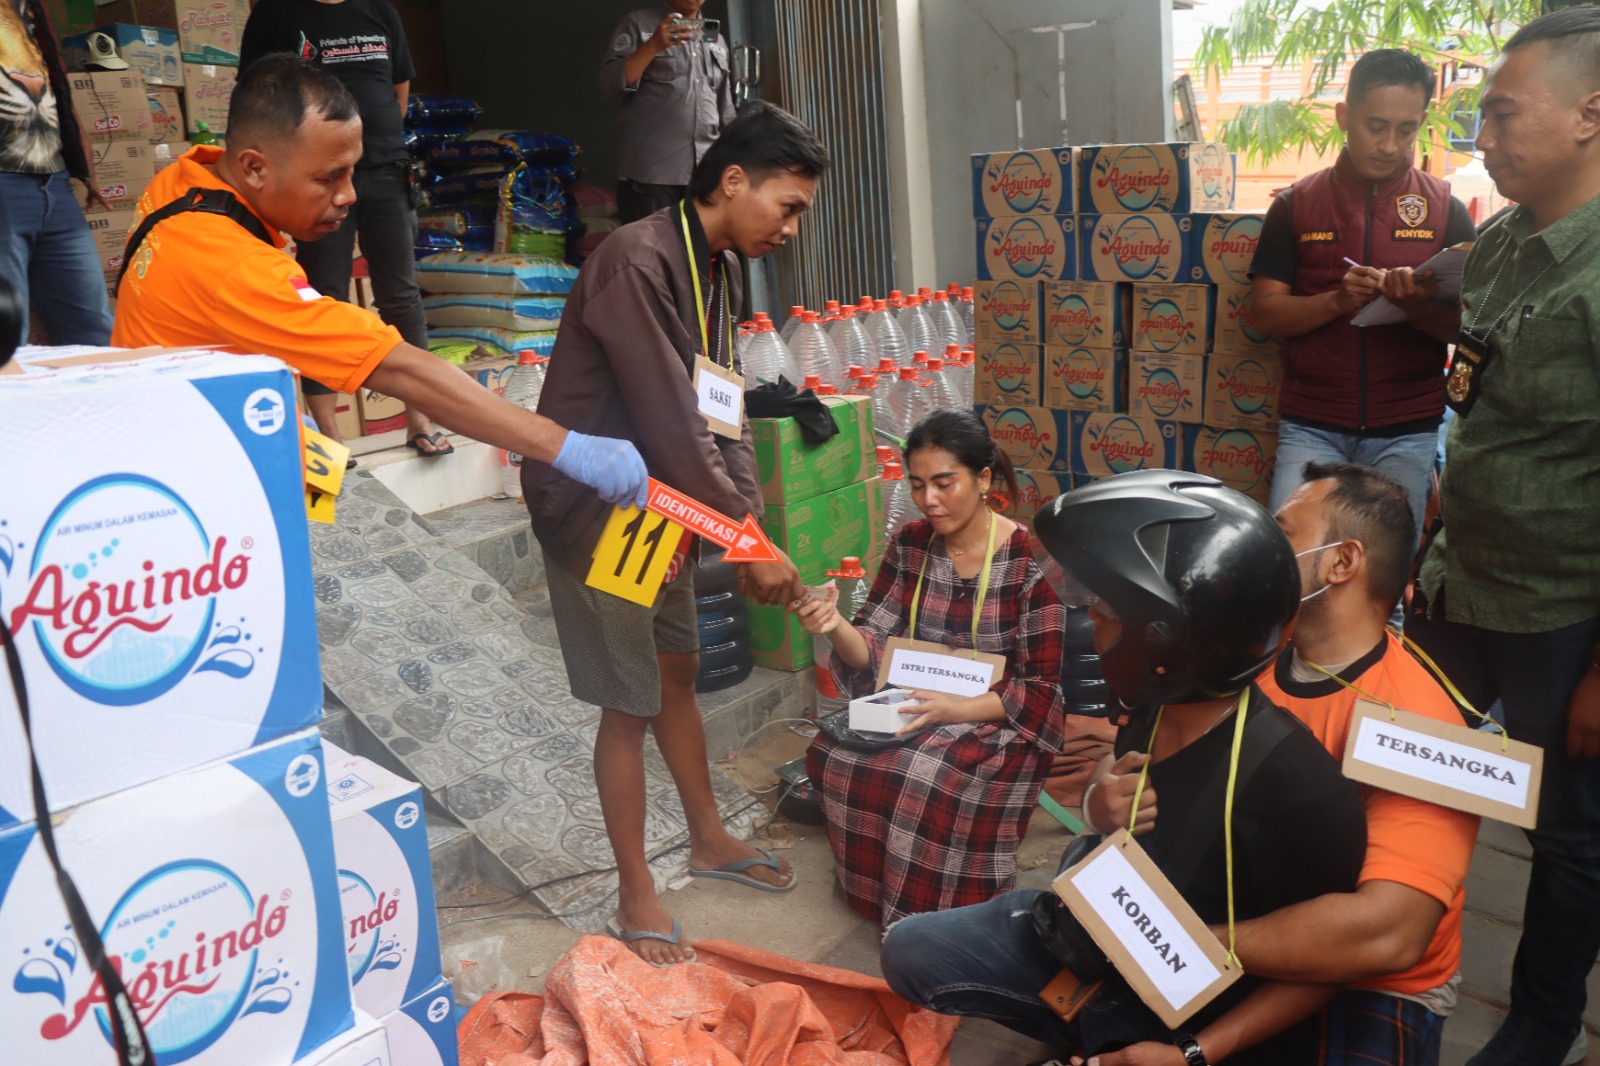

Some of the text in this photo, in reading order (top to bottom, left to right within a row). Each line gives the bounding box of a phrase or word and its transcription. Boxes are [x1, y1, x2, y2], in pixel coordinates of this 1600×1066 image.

[320, 37, 348, 47] Friends
[1395, 229, 1434, 239] PENYIDIK
[709, 387, 732, 408] SAKSI
[56, 508, 178, 536] AIR MINUM DALAM KEMASAN
[655, 492, 738, 543] IDENTIFIKASI
[621, 509, 669, 586] 11
[0, 535, 253, 659] Aguindo
[901, 662, 986, 684] ISTRI TERSANGKA
[1375, 732, 1517, 786] TERSANGKA
[116, 880, 228, 930] AIR MINUM DALAM KEMASAN
[1111, 885, 1187, 974] KORBAN
